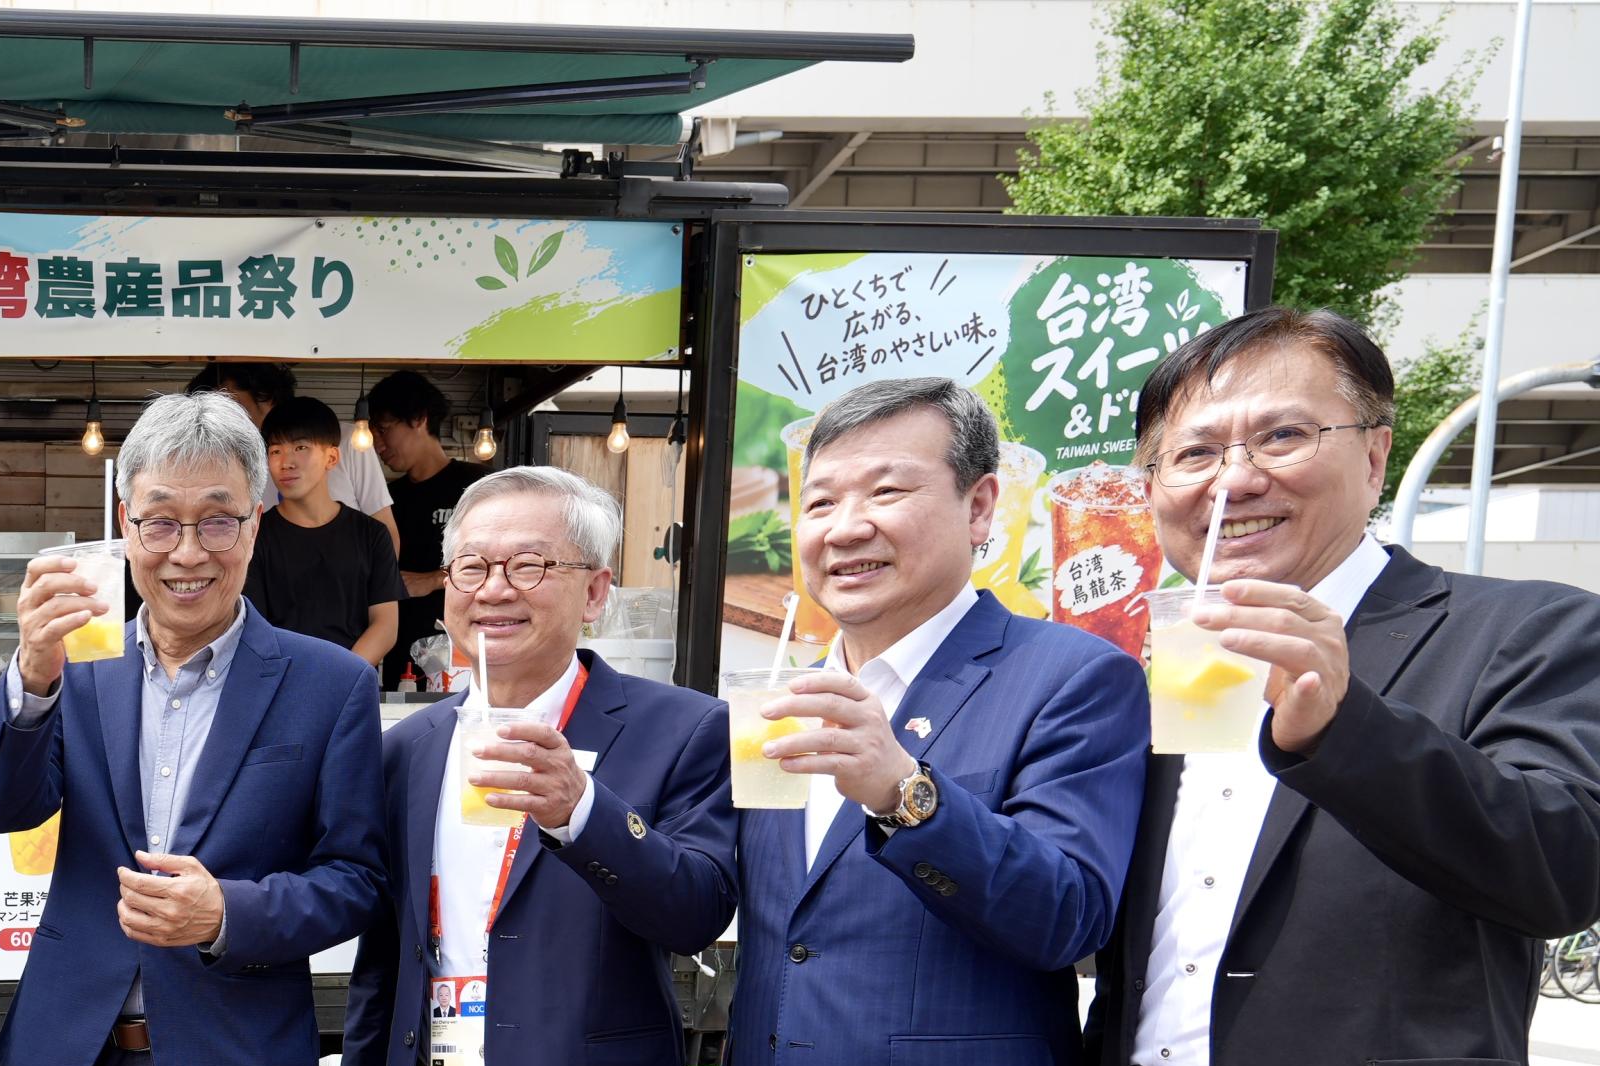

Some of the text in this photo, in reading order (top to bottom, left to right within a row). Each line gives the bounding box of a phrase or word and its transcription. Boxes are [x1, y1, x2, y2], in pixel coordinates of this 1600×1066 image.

[801, 265, 913, 320] ひとくちで
[1036, 261, 1153, 345] 台湾
[842, 301, 922, 343] 広がる、
[816, 311, 997, 385] 台湾のやさしい味。
[1056, 442, 1100, 460] TAIWAN
[1068, 553, 1104, 582] 台湾
[468, 1005, 485, 1014] NOC
